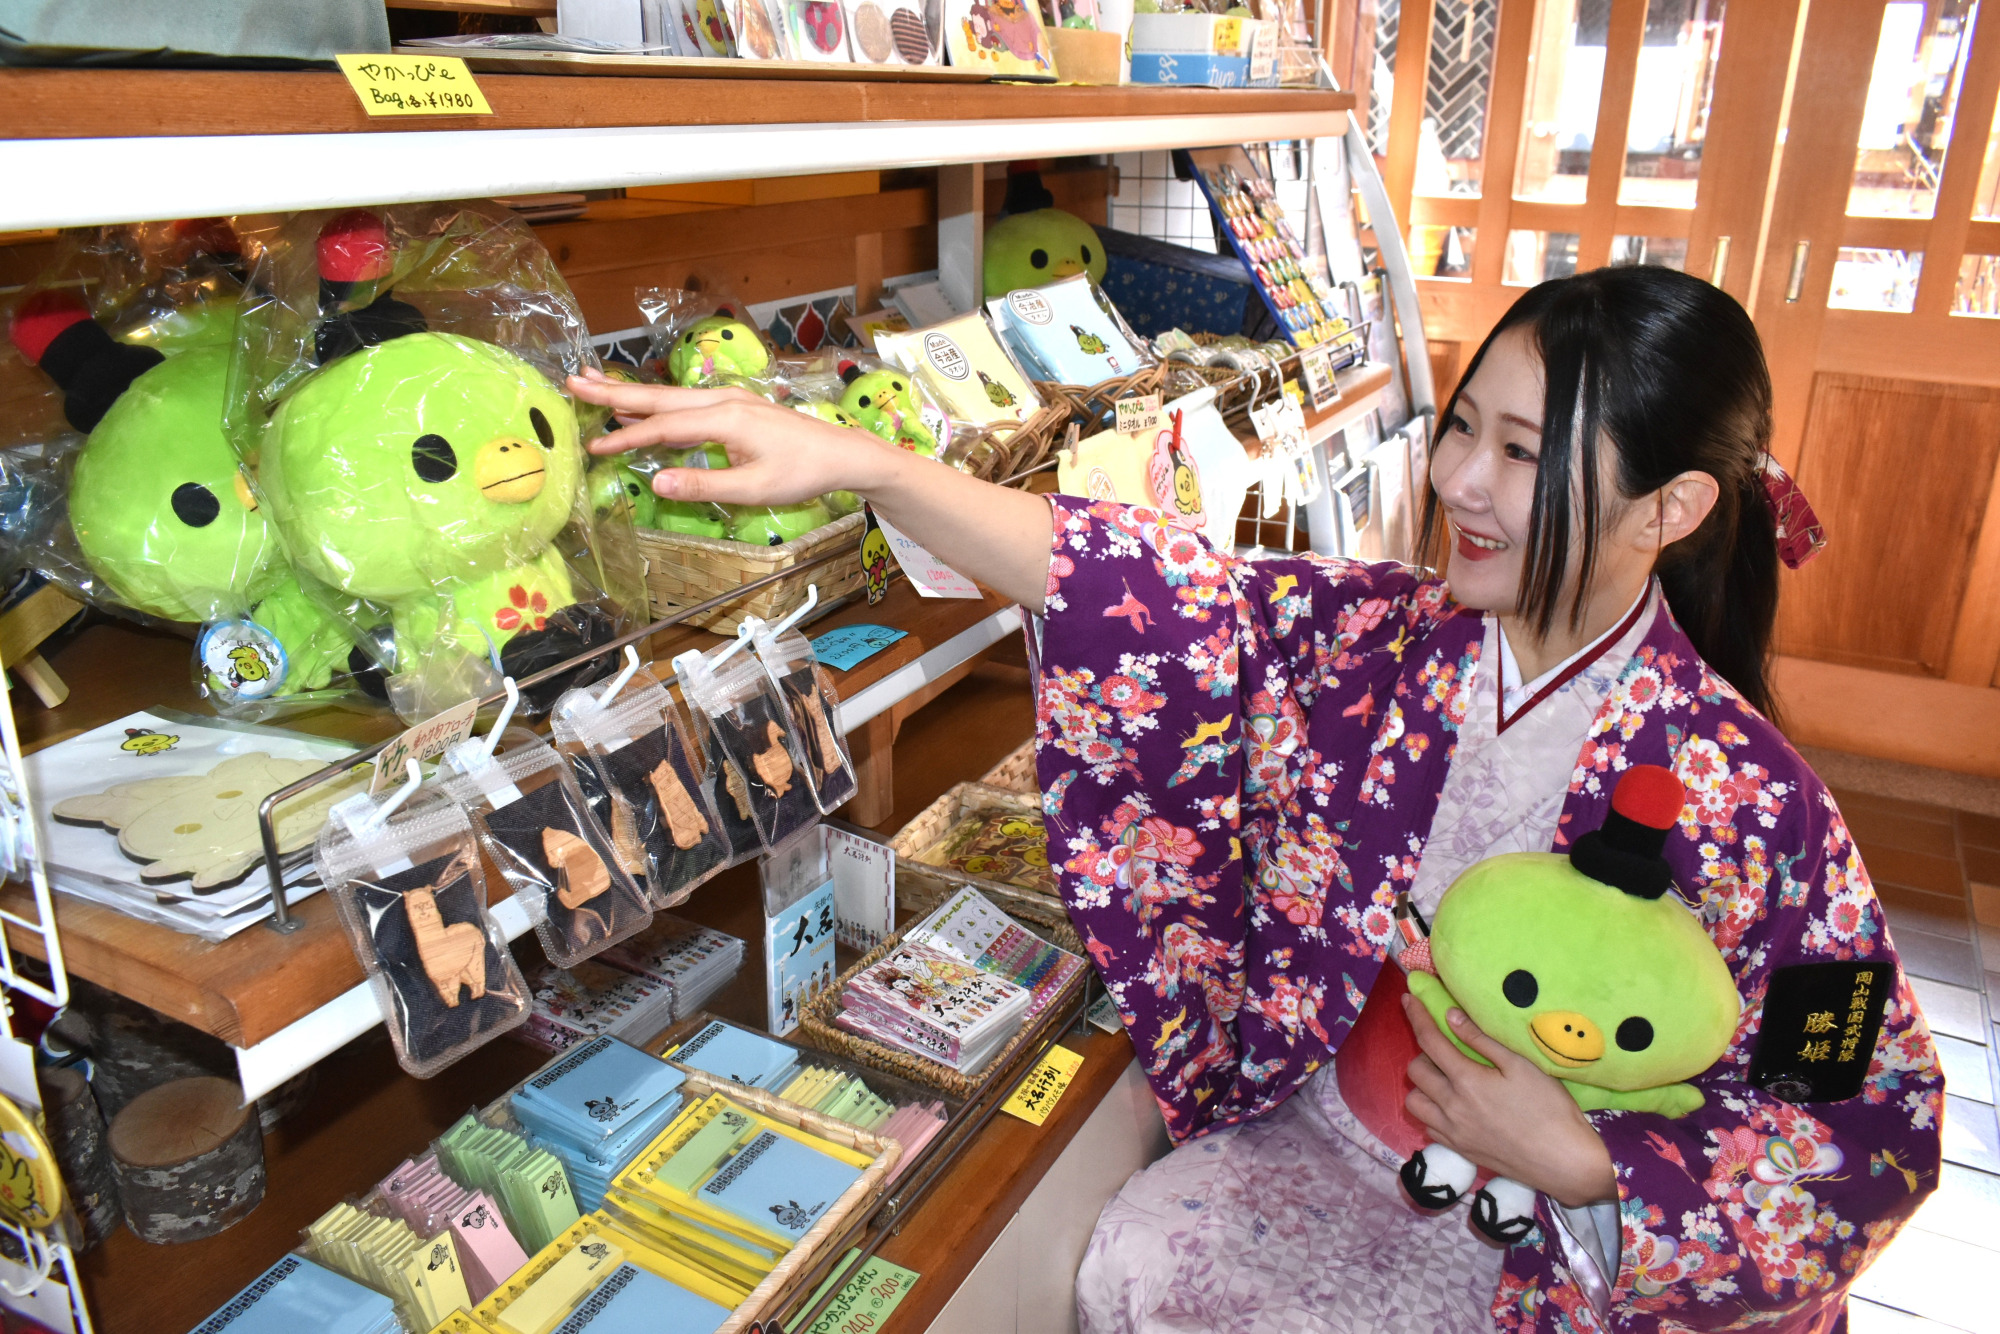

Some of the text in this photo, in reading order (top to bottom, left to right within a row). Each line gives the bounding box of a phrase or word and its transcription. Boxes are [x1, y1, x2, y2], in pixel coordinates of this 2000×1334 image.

[934, 348, 960, 364] 今治産
[932, 977, 991, 1018] 大名行列
[903, 1026, 950, 1058] 大名行列
[1797, 1010, 1838, 1063] 勝姫
[1025, 1065, 1061, 1111] 大名行列
